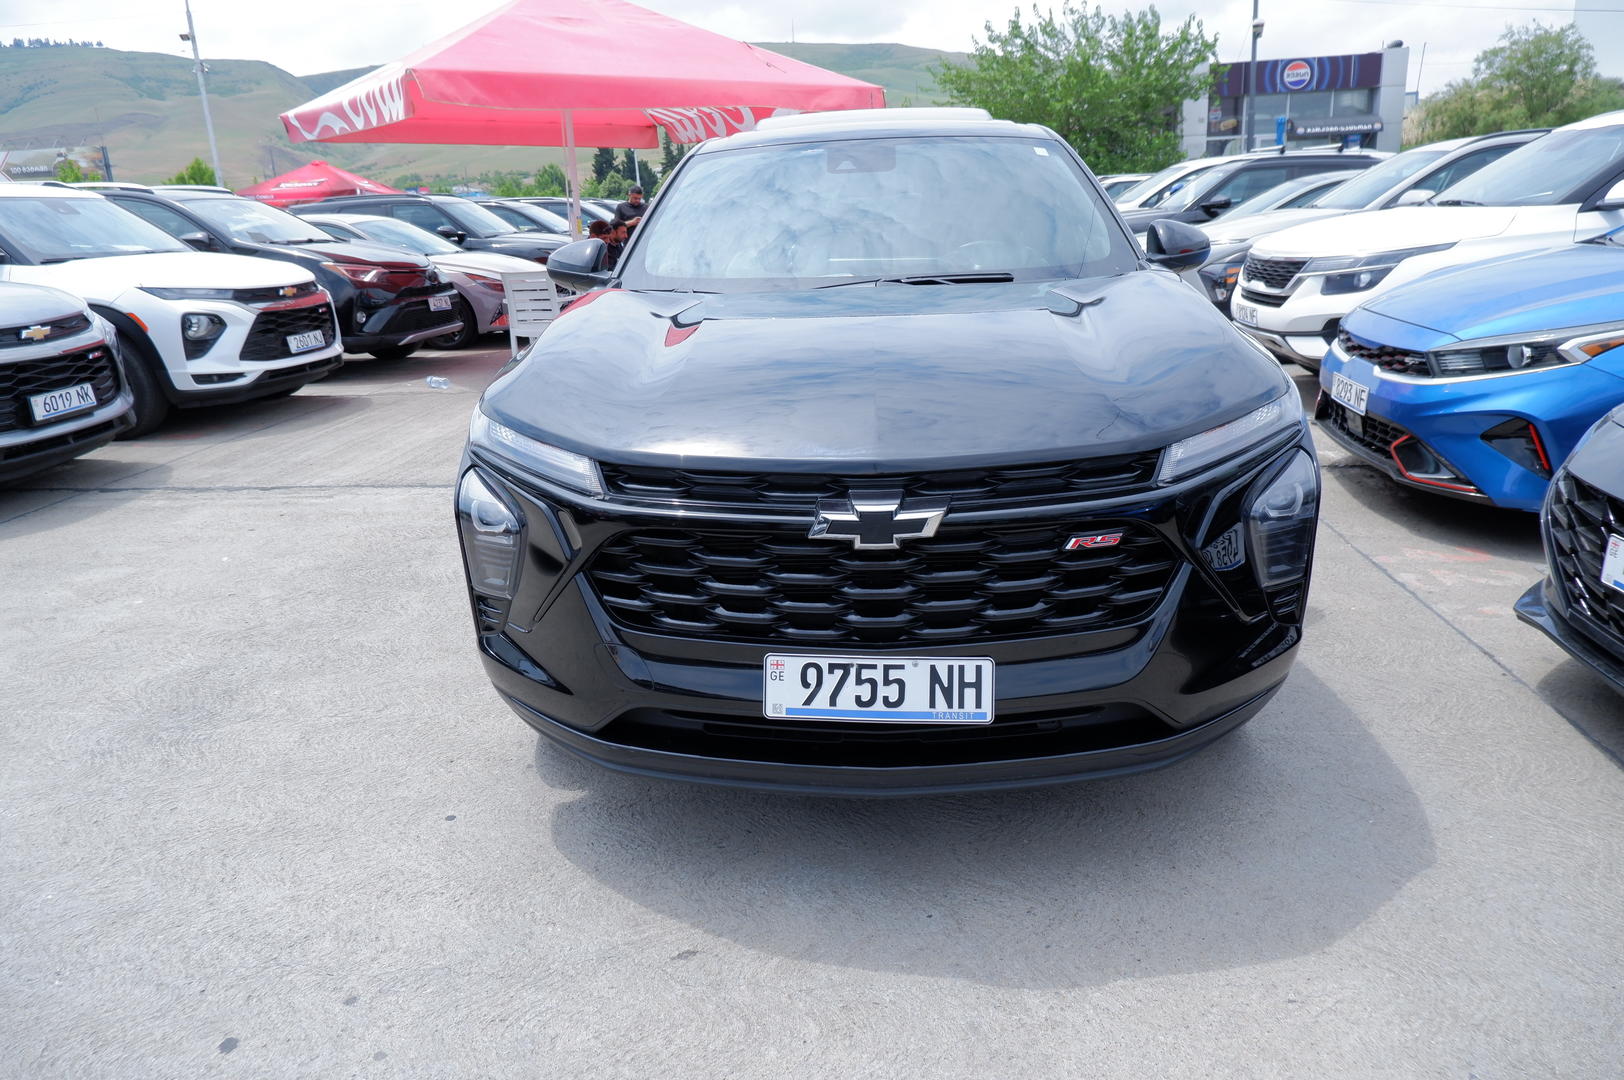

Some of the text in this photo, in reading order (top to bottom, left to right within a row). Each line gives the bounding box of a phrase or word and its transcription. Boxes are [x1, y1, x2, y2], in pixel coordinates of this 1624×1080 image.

[43, 385, 93, 413] 6019 NK
[1335, 377, 1366, 409] 8293 NF
[1065, 532, 1123, 550] RS
[770, 670, 785, 682] GE
[799, 661, 983, 710] 9755 NH
[931, 711, 975, 720] TRANSIT
